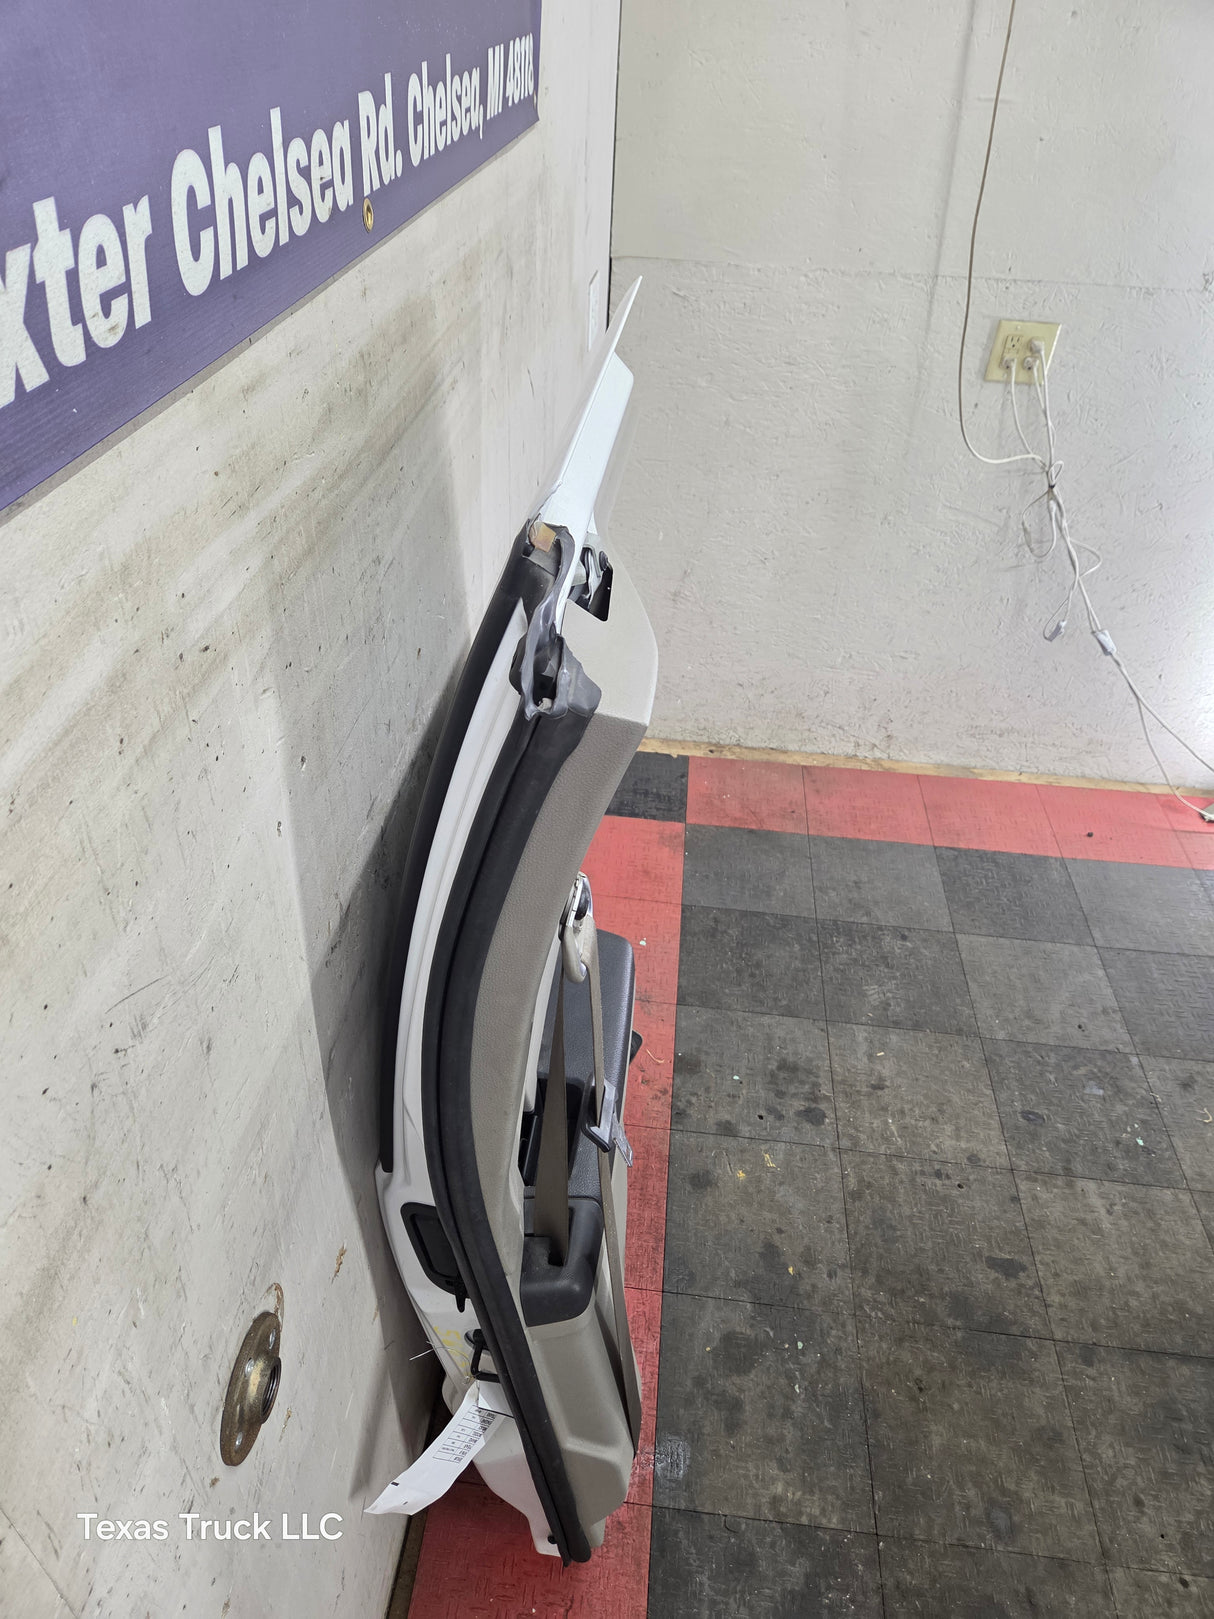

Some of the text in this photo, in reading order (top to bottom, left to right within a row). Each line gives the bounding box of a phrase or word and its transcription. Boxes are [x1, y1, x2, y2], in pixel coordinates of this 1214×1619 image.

[171, 107, 353, 296] Chelsea
[358, 72, 403, 197] Rd.
[407, 53, 484, 167] Chelsea,
[487, 43, 505, 120] MI
[506, 32, 535, 107] 48118
